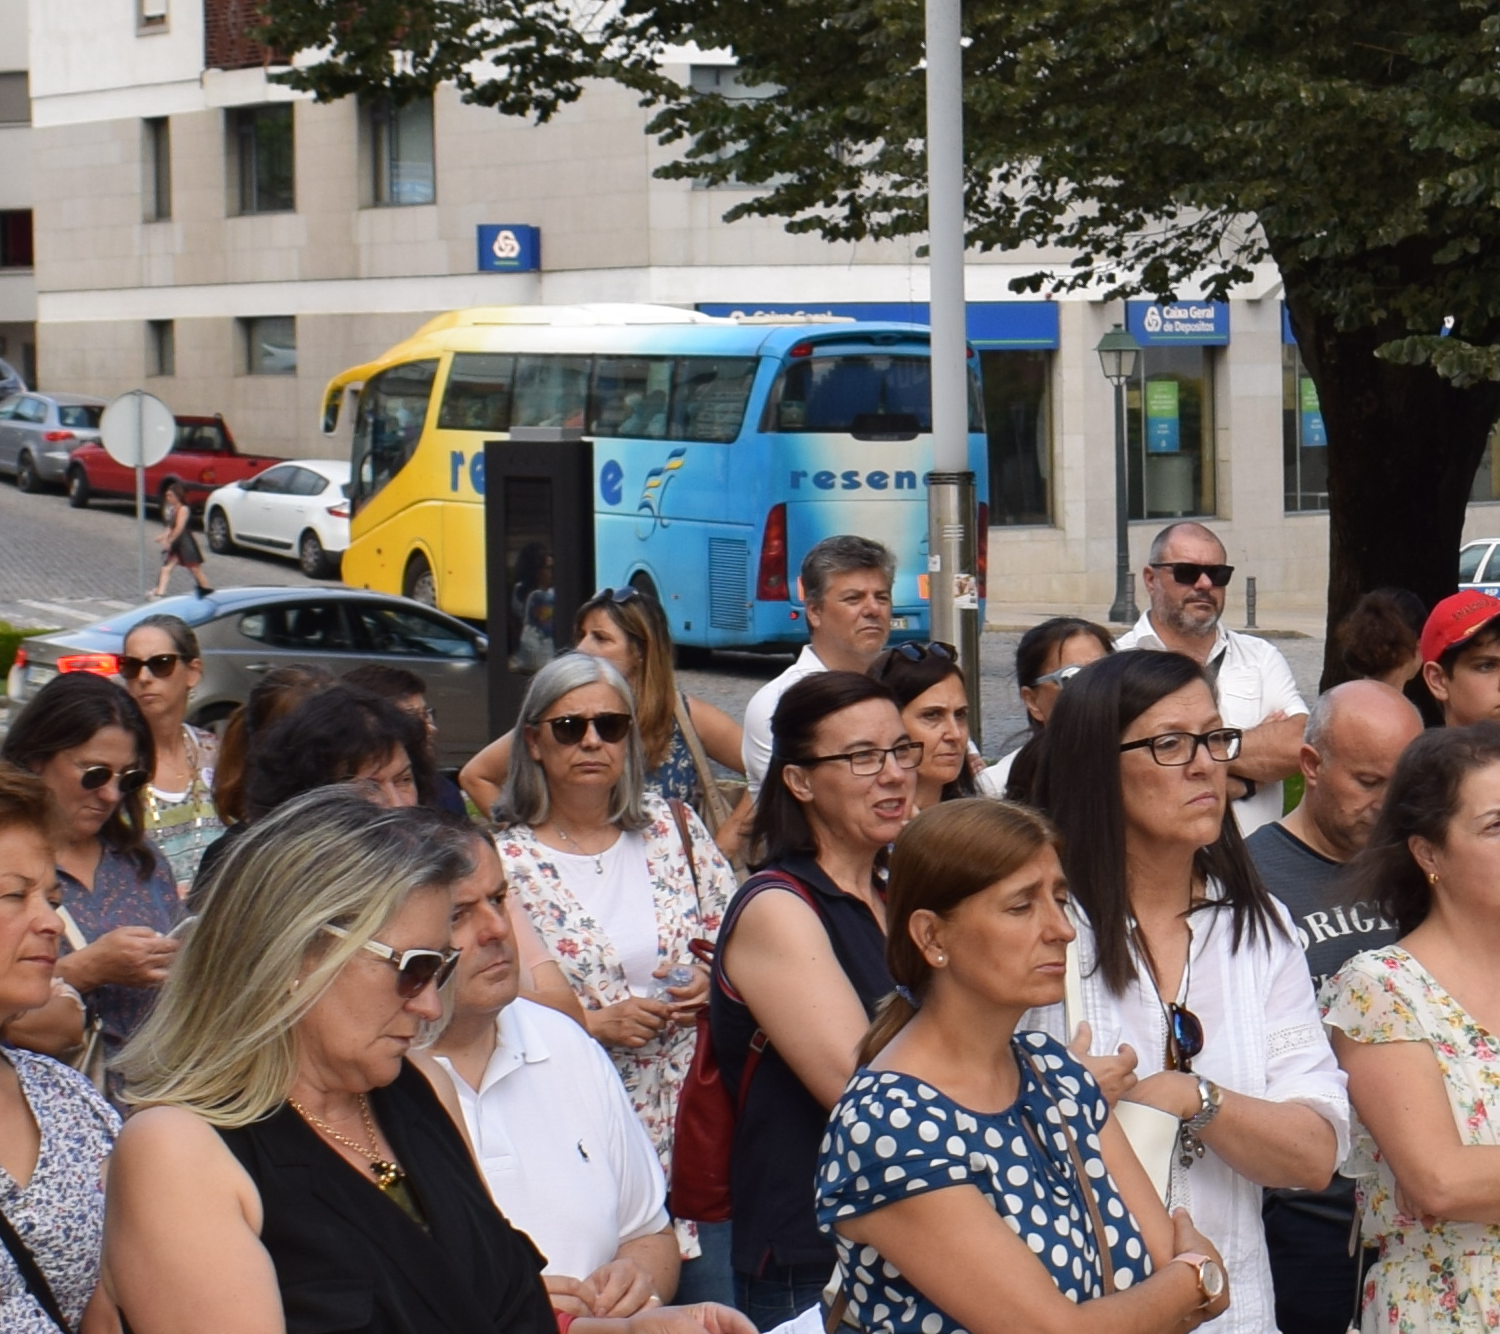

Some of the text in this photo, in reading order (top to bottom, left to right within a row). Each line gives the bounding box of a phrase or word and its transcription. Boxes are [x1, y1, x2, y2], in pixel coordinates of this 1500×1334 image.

[1163, 306, 1215, 319] Caixa Geral
[1163, 320, 1173, 332] de
[790, 470, 930, 490] resen
